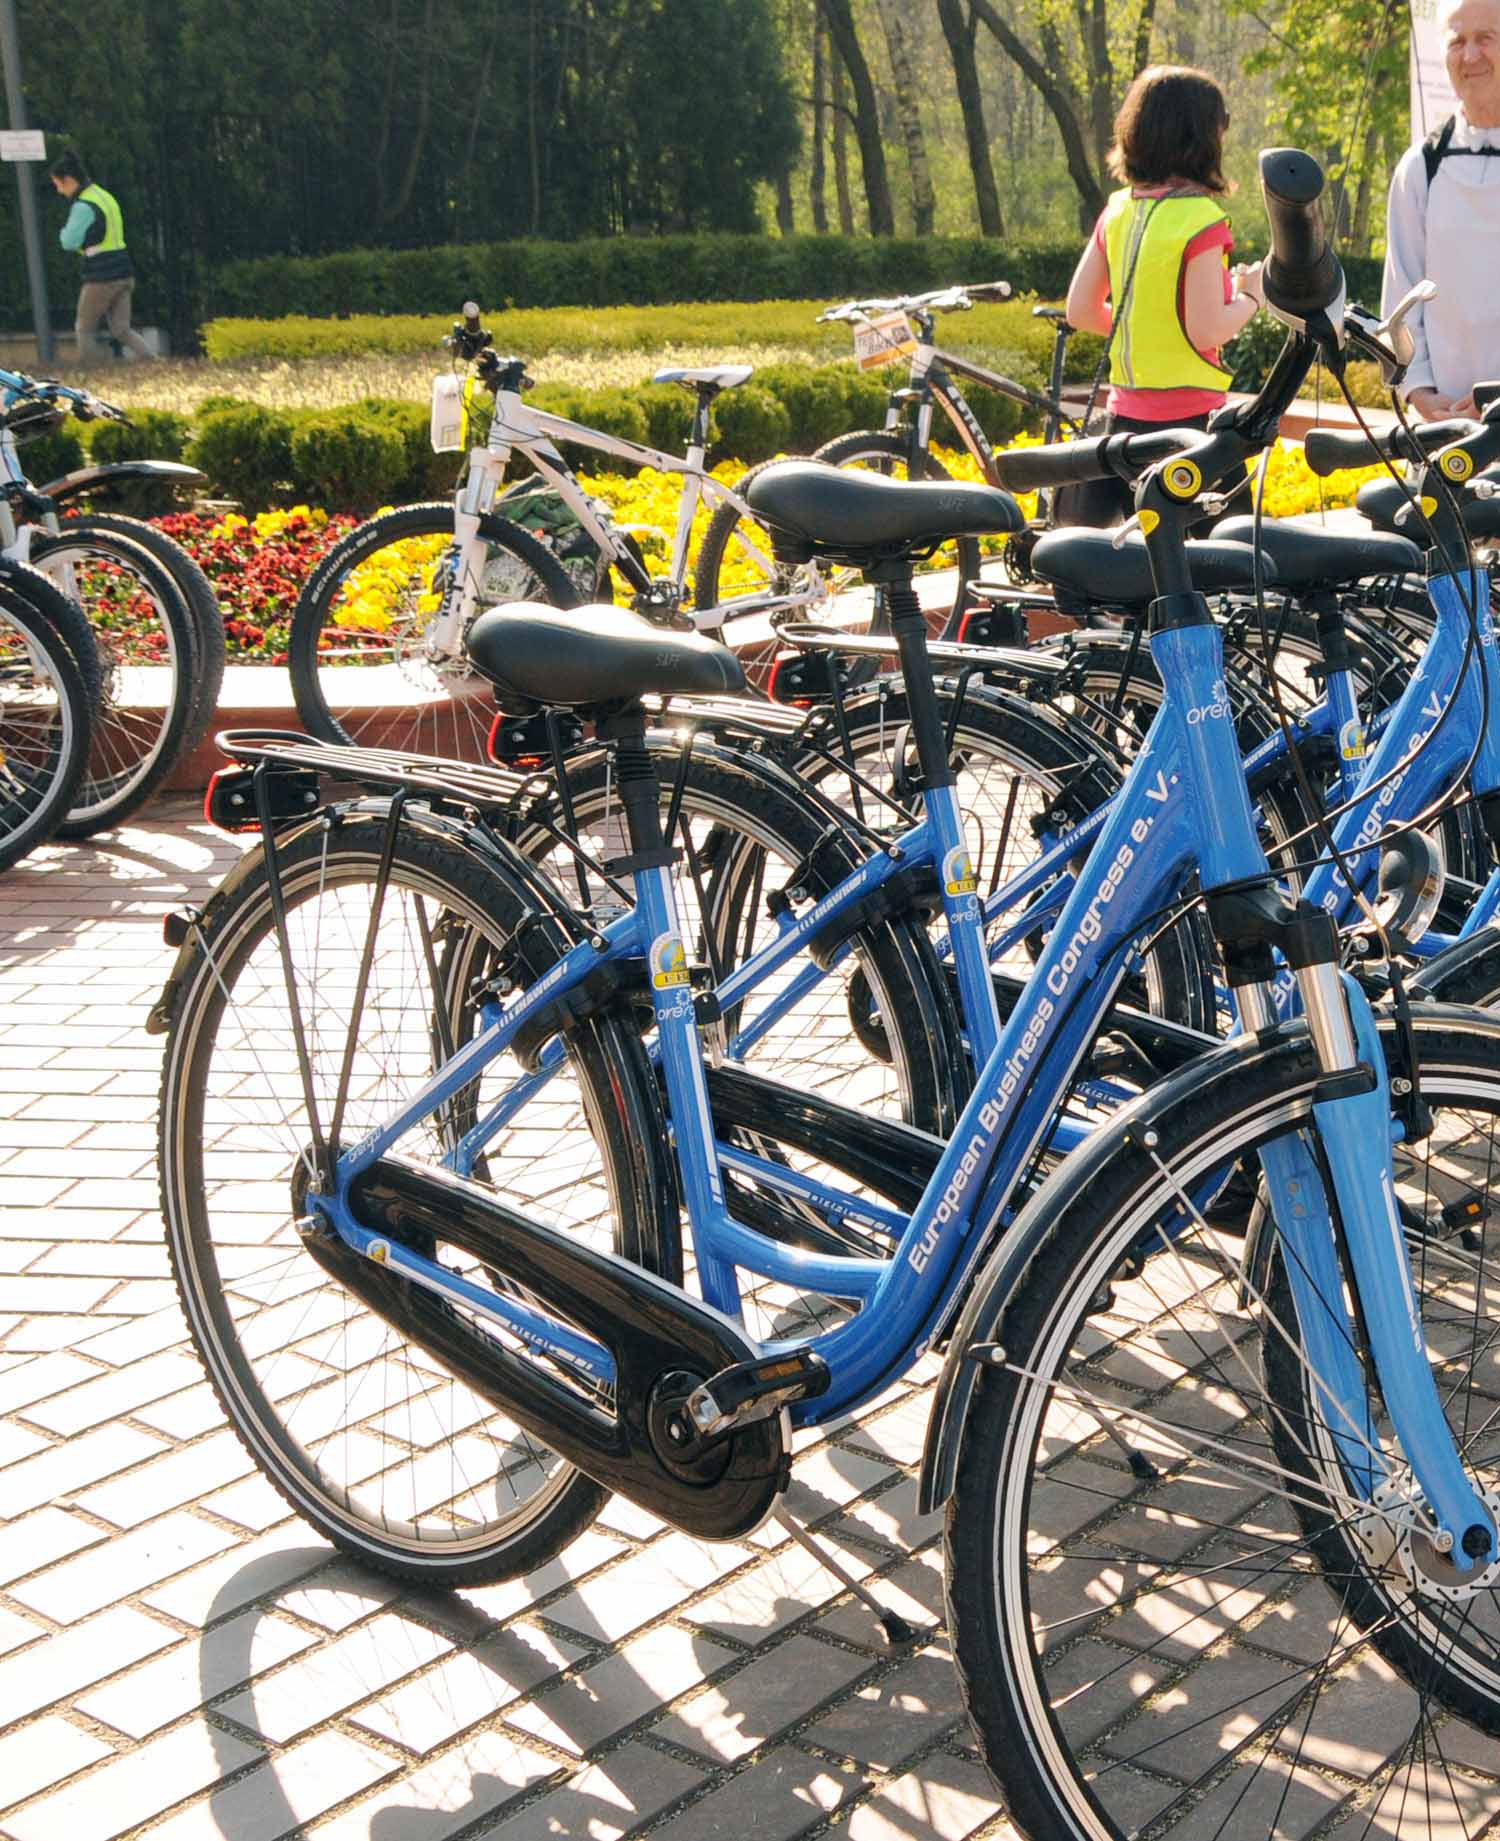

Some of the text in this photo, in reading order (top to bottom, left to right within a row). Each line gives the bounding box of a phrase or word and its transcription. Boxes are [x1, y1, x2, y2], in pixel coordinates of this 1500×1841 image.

[907, 1133, 987, 1275] European
[978, 997, 1055, 1134] Business
[1046, 843, 1135, 997] Congress
[1130, 815, 1154, 844] e.
[1144, 768, 1179, 803] V.
